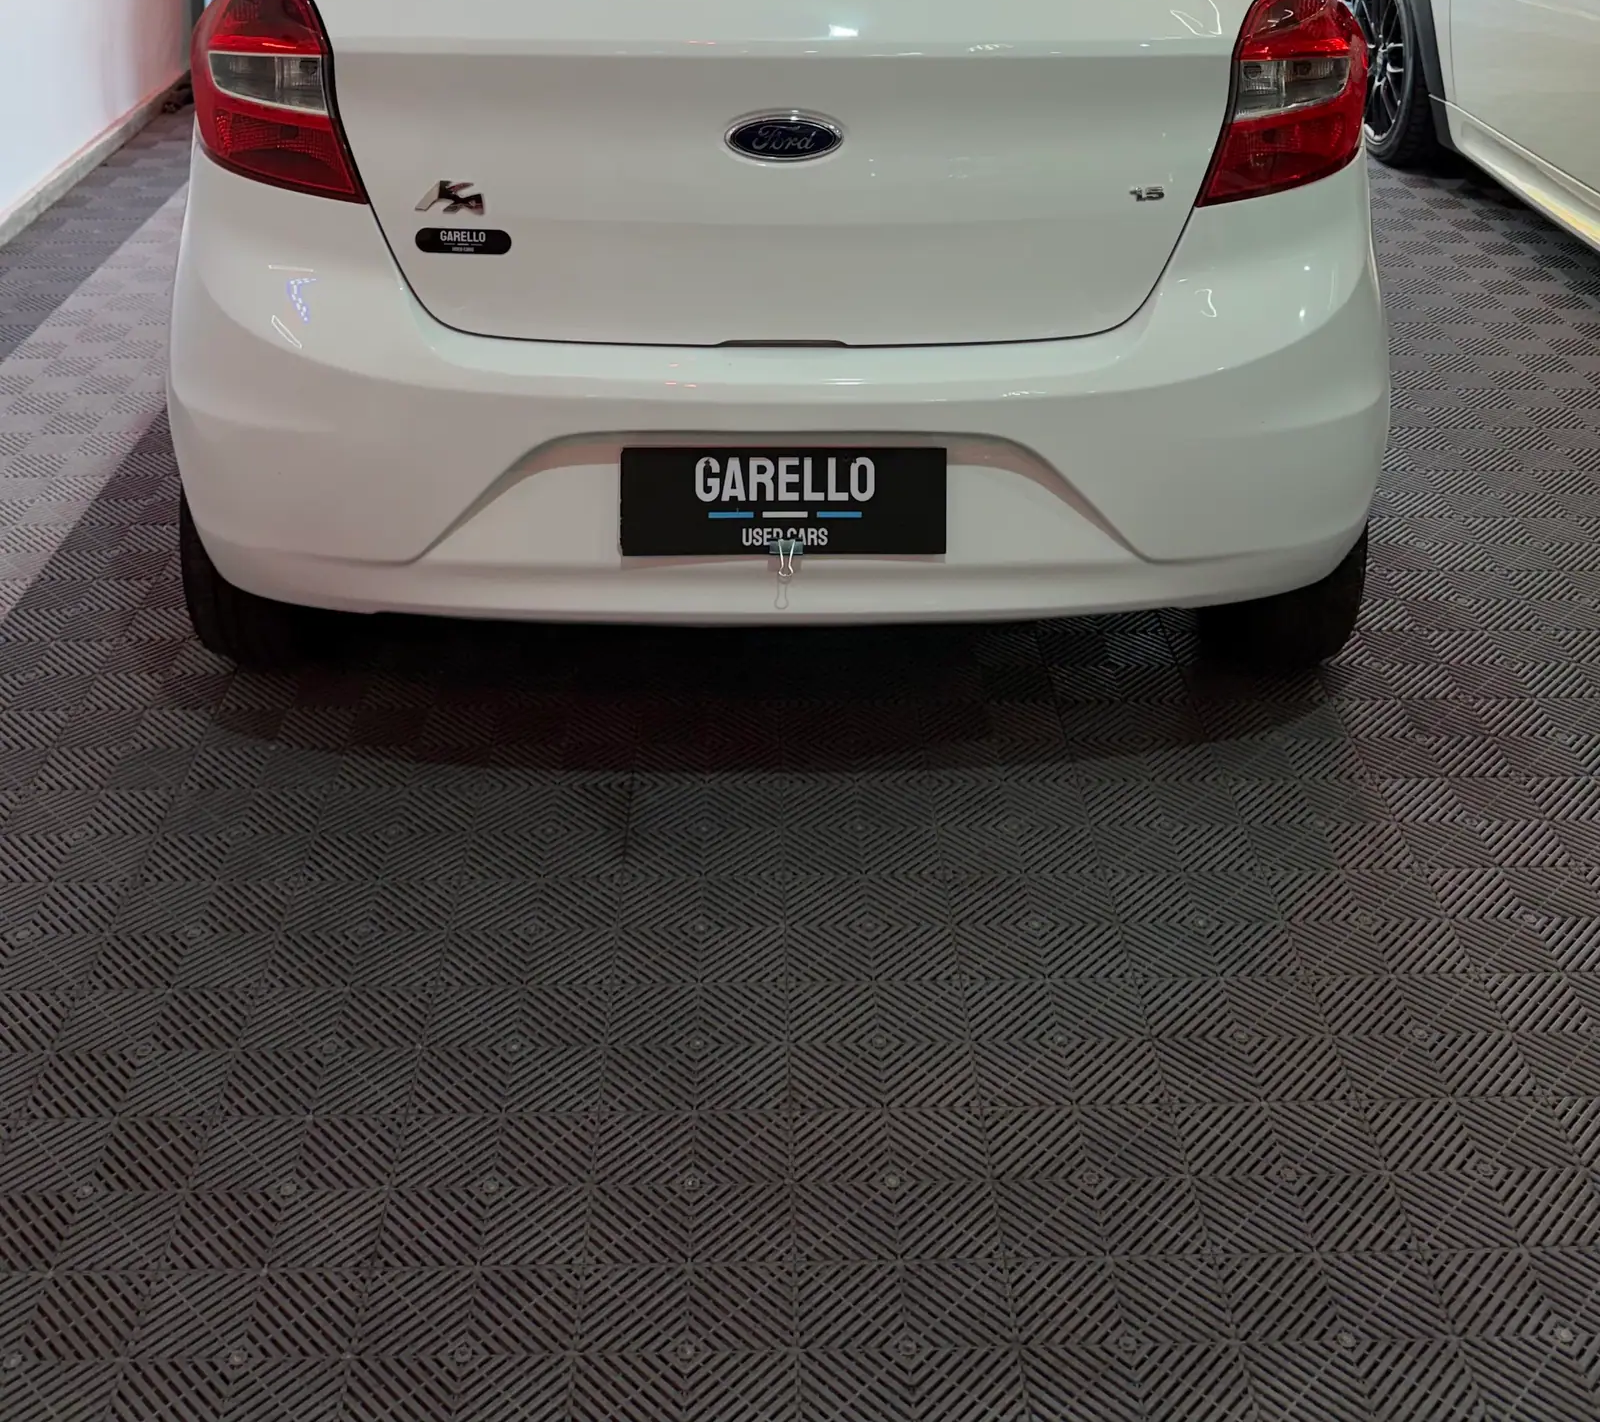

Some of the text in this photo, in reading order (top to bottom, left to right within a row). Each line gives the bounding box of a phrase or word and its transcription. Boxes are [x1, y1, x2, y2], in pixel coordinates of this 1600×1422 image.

[752, 125, 817, 150] Ford
[440, 230, 487, 243] GARELLO
[695, 457, 876, 502] GARELLO
[742, 528, 784, 546] USED
